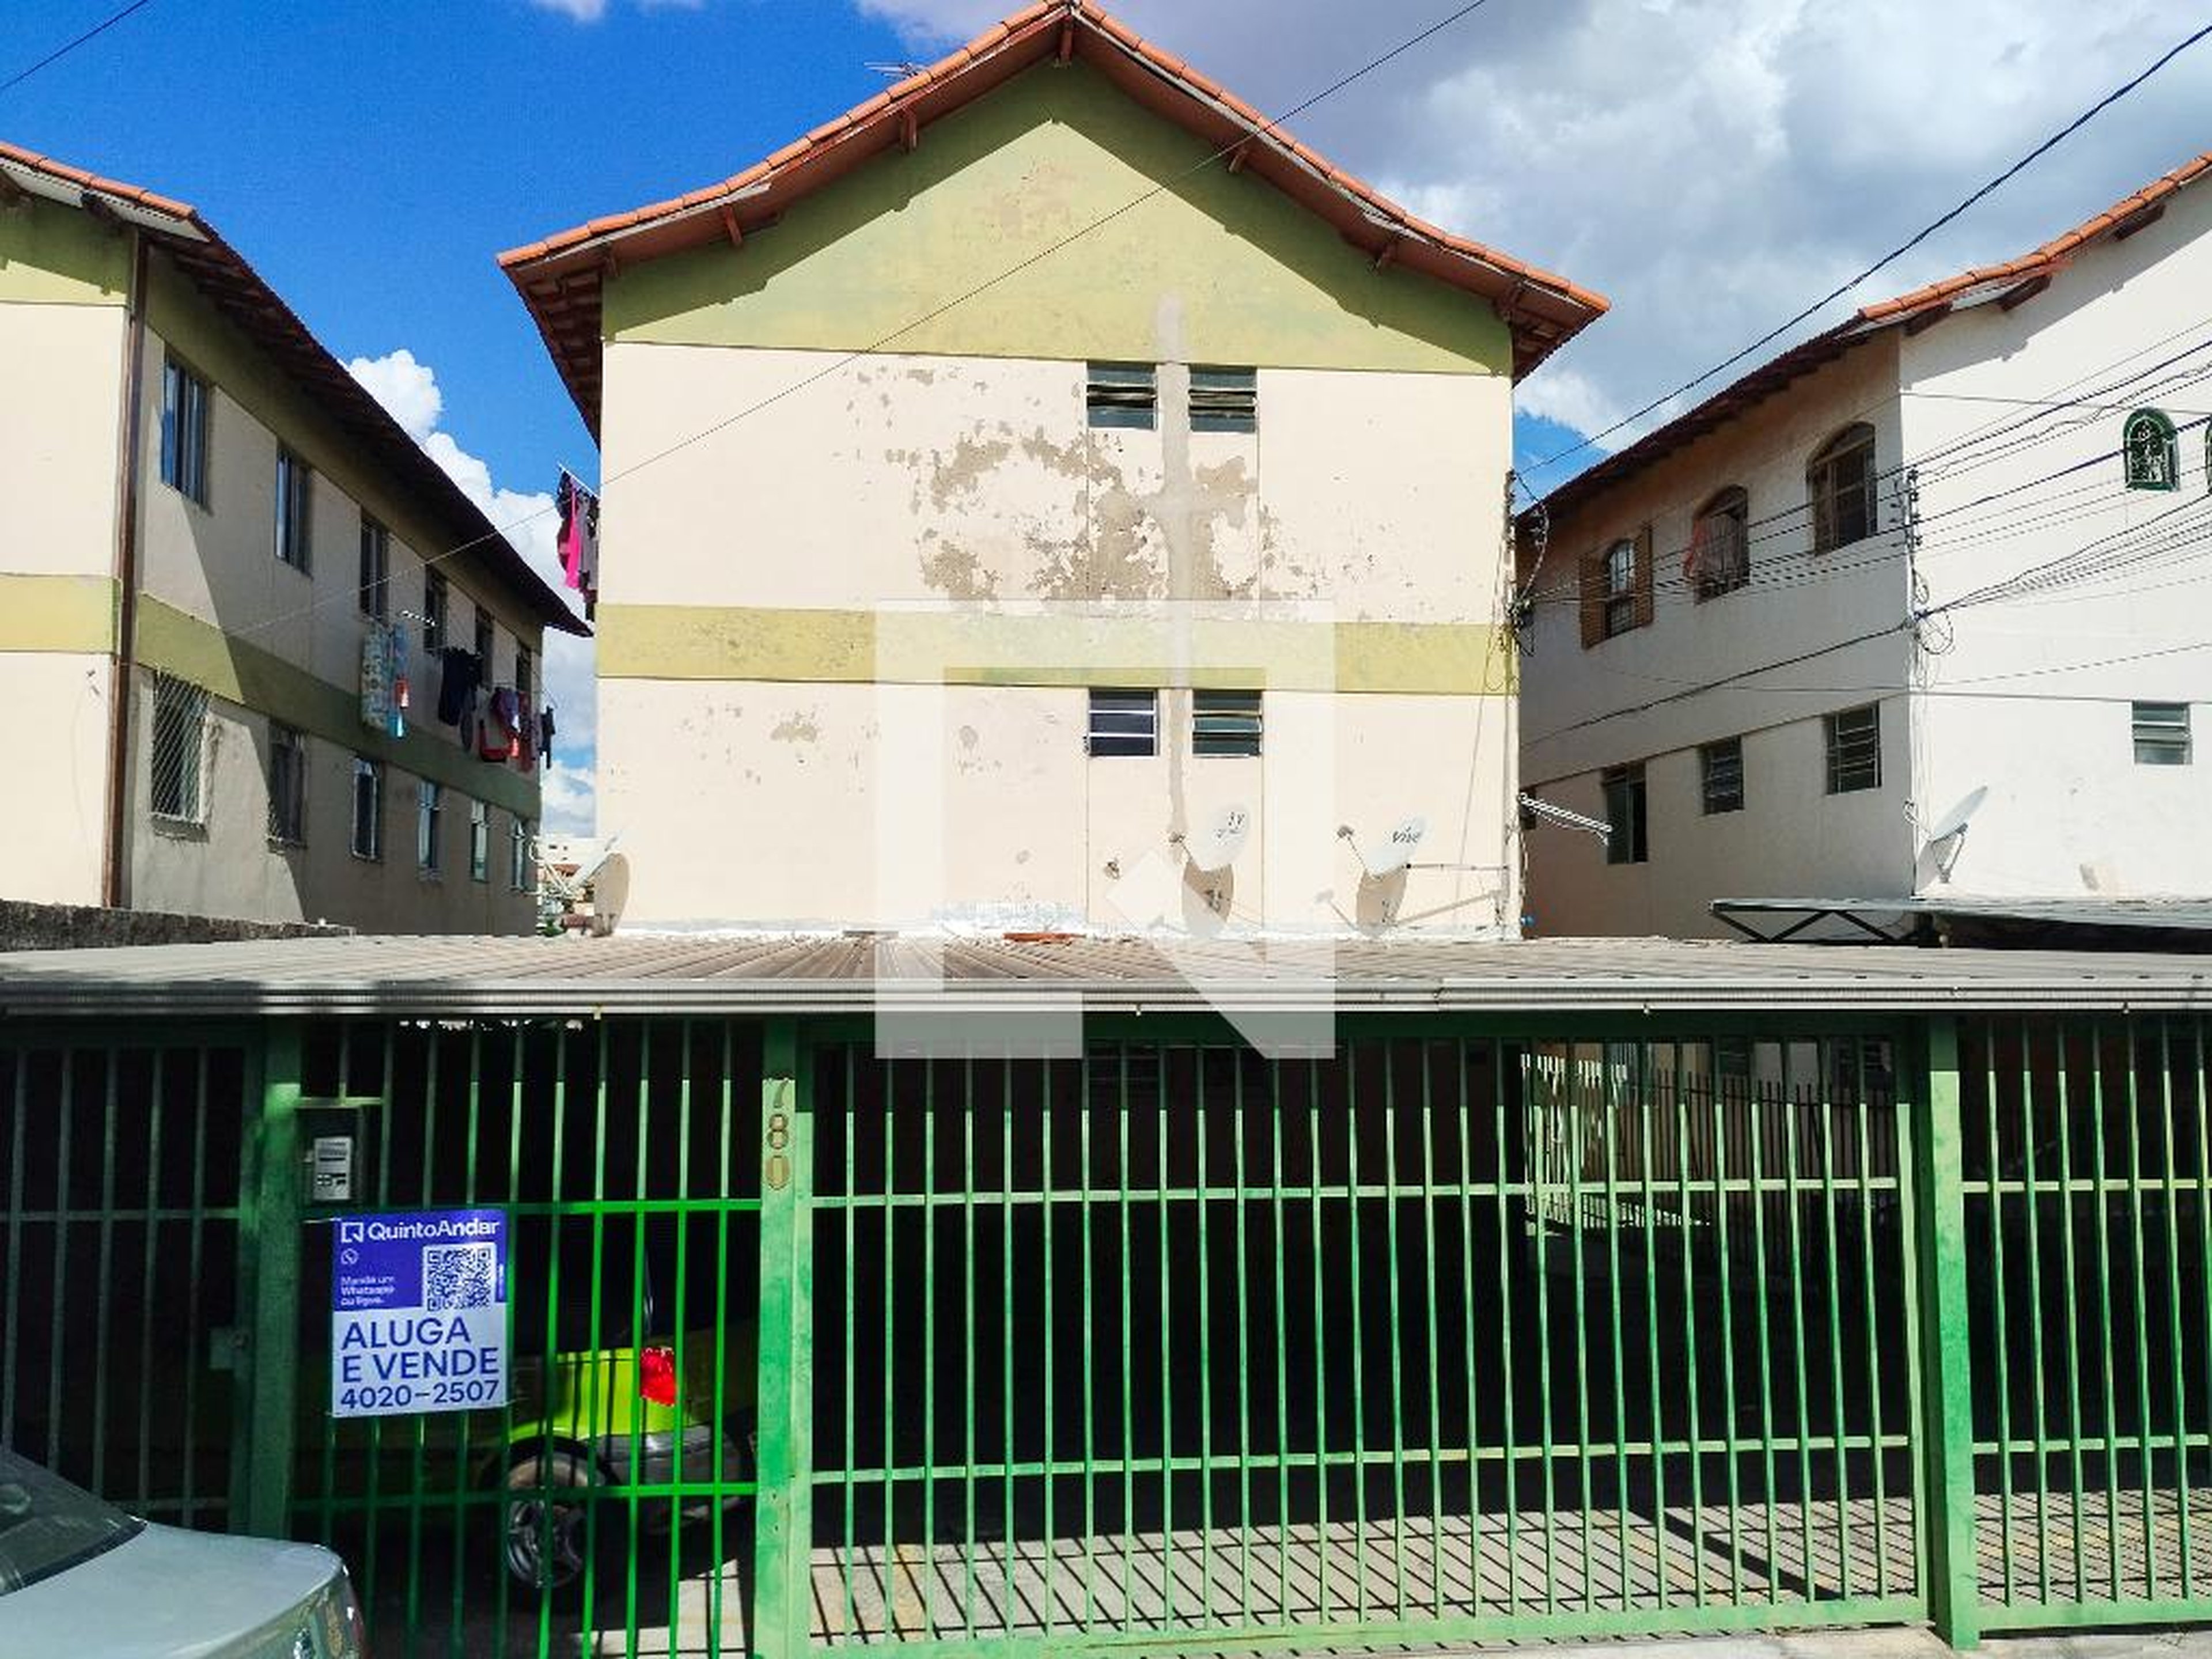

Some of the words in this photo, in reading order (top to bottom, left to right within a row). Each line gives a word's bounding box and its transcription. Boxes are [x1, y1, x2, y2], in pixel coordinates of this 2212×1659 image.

[766, 1077, 790, 1191] 780
[368, 1218, 499, 1241] QuintoAndar
[341, 1317, 471, 1350] ALUGA
[343, 1355, 362, 1383] E
[374, 1347, 499, 1380] VENDE
[340, 1380, 499, 1409] 4020-2507
